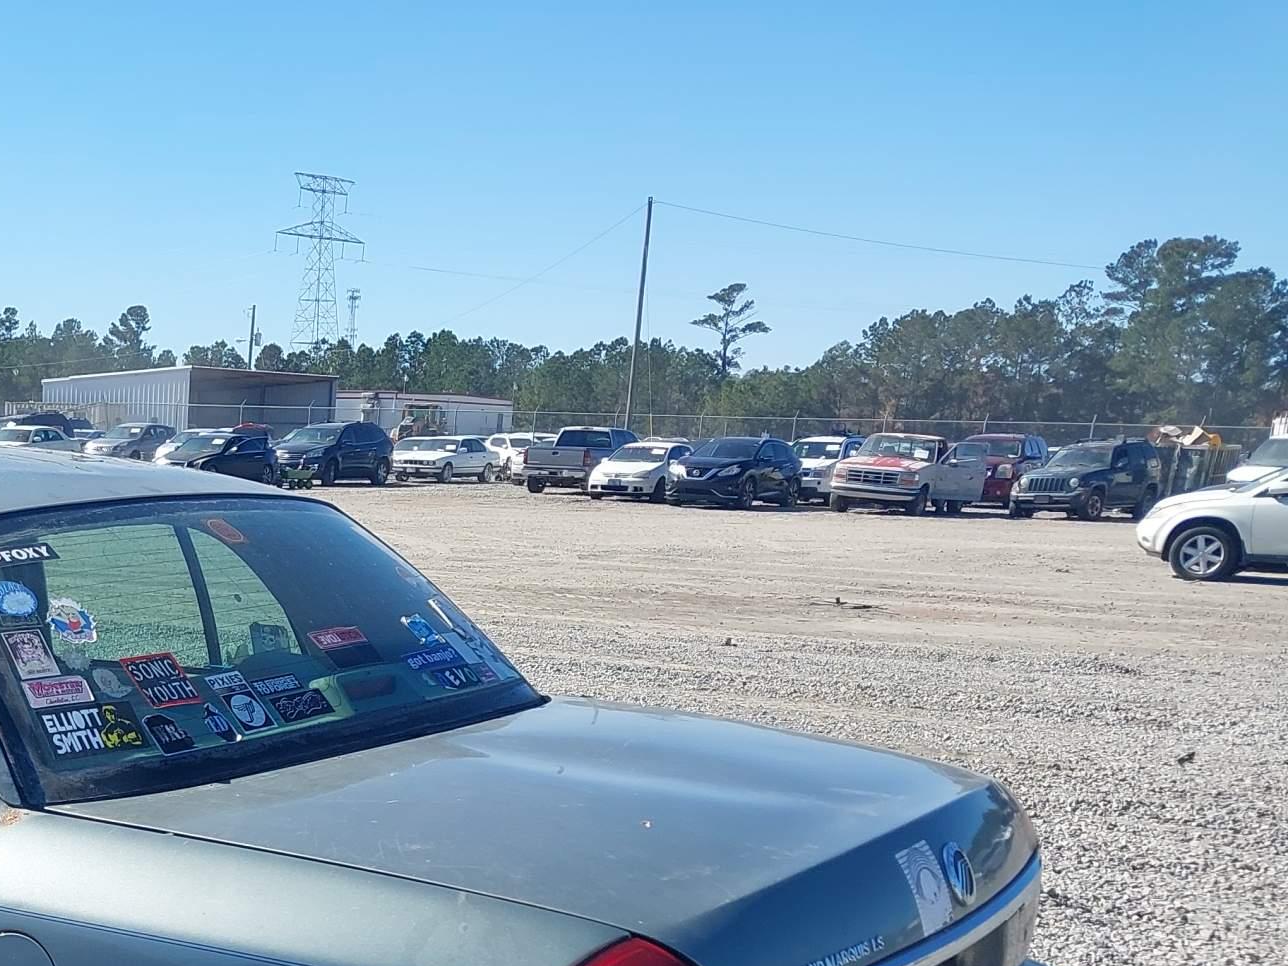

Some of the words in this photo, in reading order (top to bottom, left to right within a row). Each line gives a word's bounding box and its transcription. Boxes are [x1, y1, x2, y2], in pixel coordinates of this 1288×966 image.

[0, 545, 51, 562] FOXY
[128, 658, 179, 682] SONIC
[407, 653, 426, 670] got
[423, 648, 457, 666] banjo?
[207, 673, 242, 687] PIXIES
[142, 680, 199, 704] YOUTH
[41, 708, 103, 733] ELLIOTT
[52, 728, 105, 754] SMITH
[872, 936, 885, 952] LS
